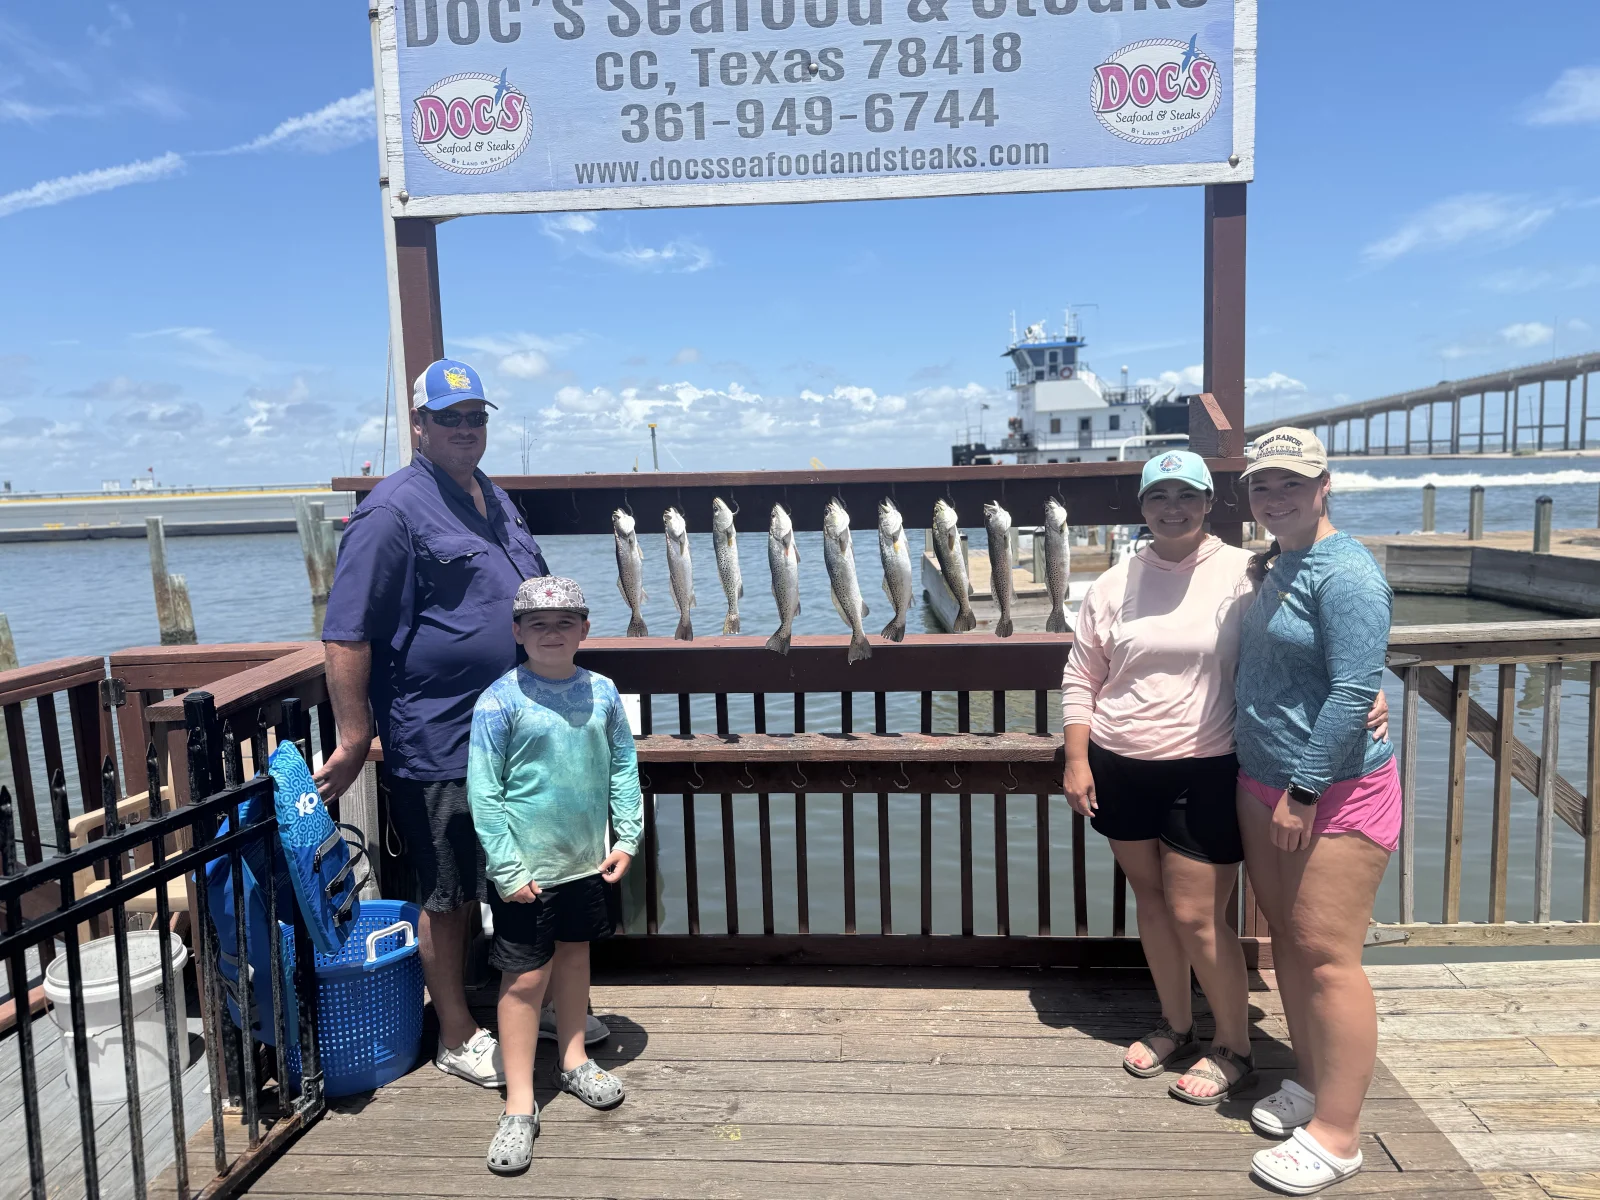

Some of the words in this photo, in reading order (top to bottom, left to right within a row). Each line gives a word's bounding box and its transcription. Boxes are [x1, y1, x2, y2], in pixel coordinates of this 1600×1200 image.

[595, 50, 677, 96] CC,
[690, 47, 845, 88] Texas
[863, 32, 1022, 81] 78418
[620, 88, 999, 143] 361-949-6744
[1116, 110, 1153, 124] Seafood
[1156, 110, 1167, 120] &
[1170, 108, 1201, 120] Steaks
[436, 142, 472, 155] Seafood
[474, 142, 484, 152] &
[487, 140, 515, 152] Steaks
[574, 141, 1049, 184] www.docsseafoodandsteaks.com
[1259, 436, 1275, 450] KING
[1276, 434, 1303, 447] RANCH
